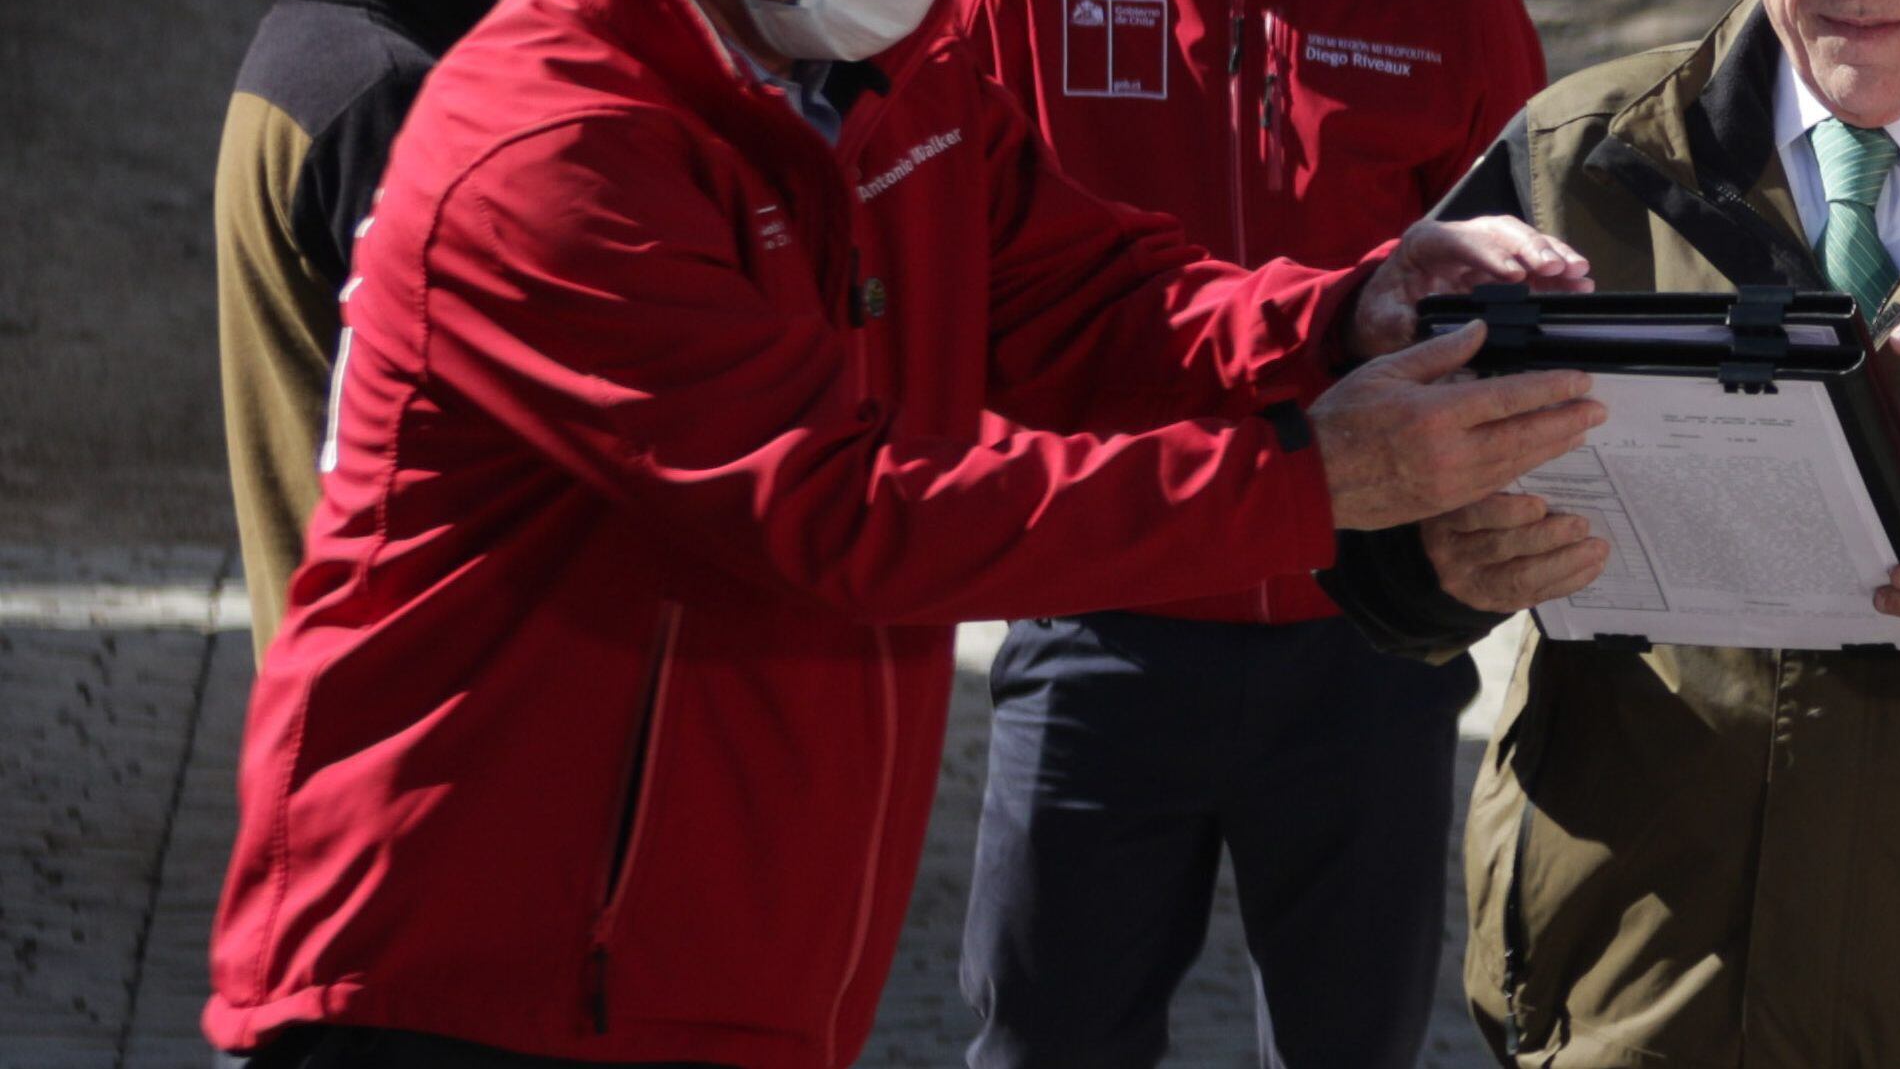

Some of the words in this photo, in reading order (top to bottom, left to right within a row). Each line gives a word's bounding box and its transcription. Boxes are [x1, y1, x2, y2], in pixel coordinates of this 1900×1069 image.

[1305, 46, 1349, 67] Diego
[1352, 52, 1412, 77] Riveaux
[856, 158, 914, 203] Antonio
[909, 128, 963, 165] Walker
